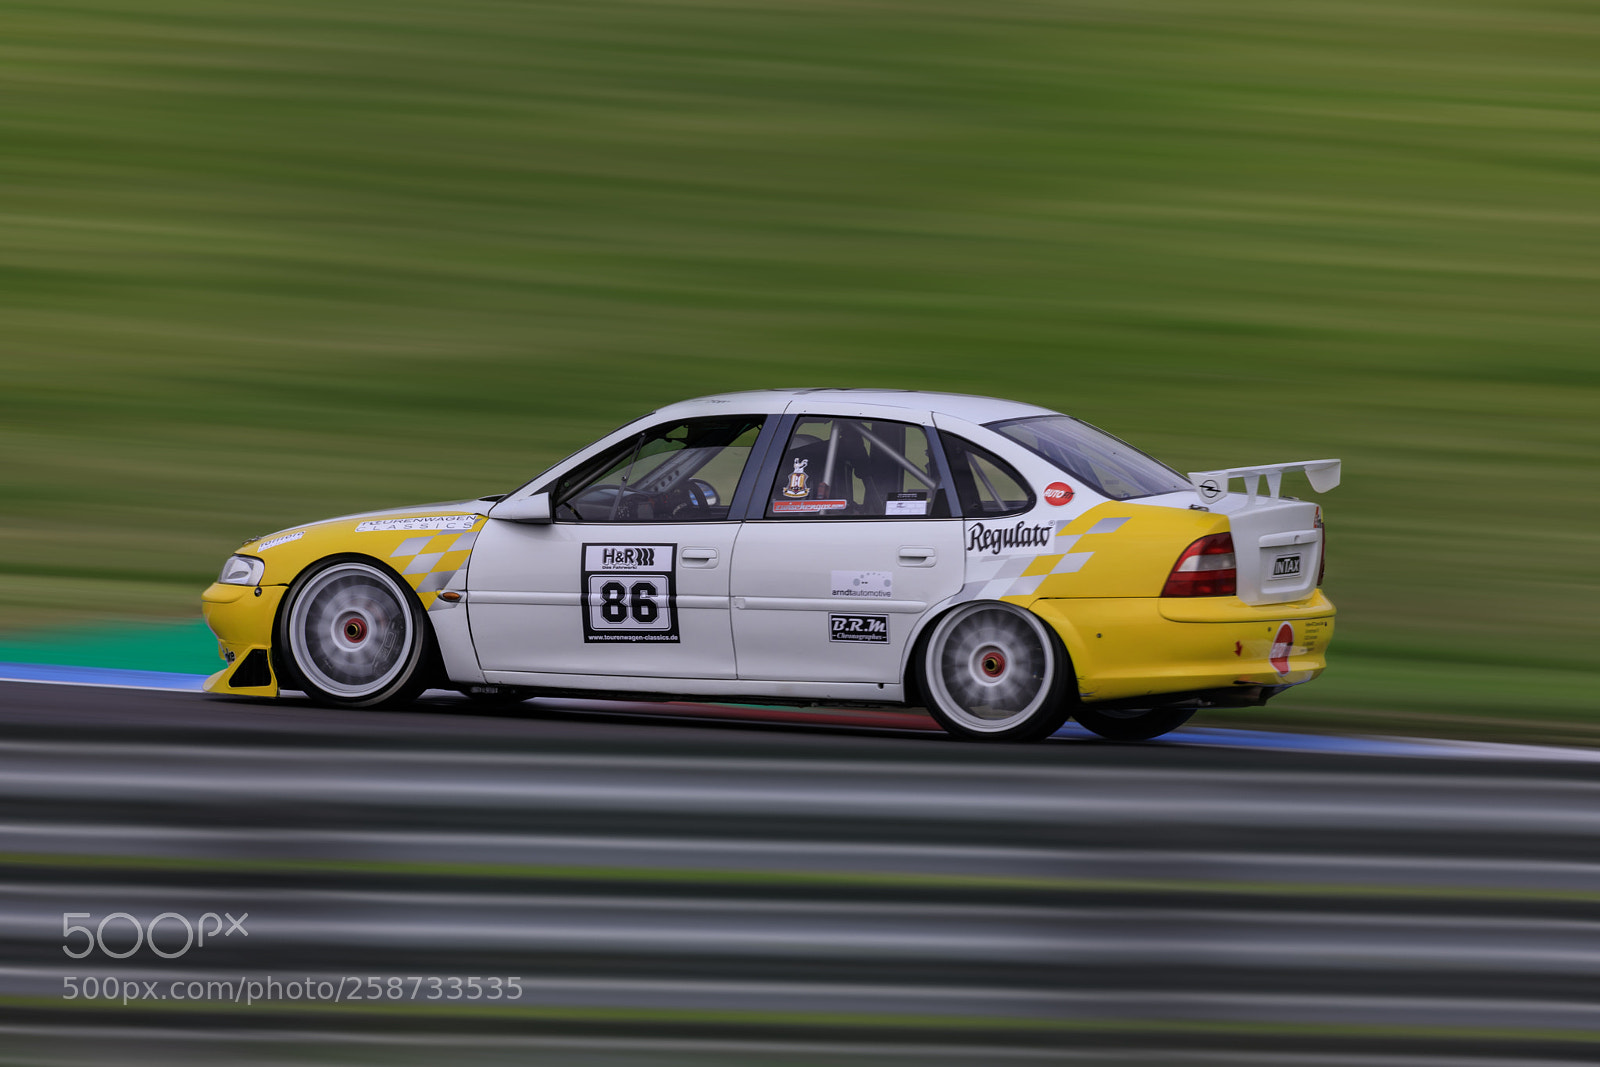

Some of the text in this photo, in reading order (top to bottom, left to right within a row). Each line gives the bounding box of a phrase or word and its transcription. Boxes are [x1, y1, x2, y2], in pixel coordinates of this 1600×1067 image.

[356, 522, 472, 532] CLASSICS
[603, 548, 635, 564] H&R
[832, 589, 891, 597] arndtautomotive
[601, 581, 659, 624] 86
